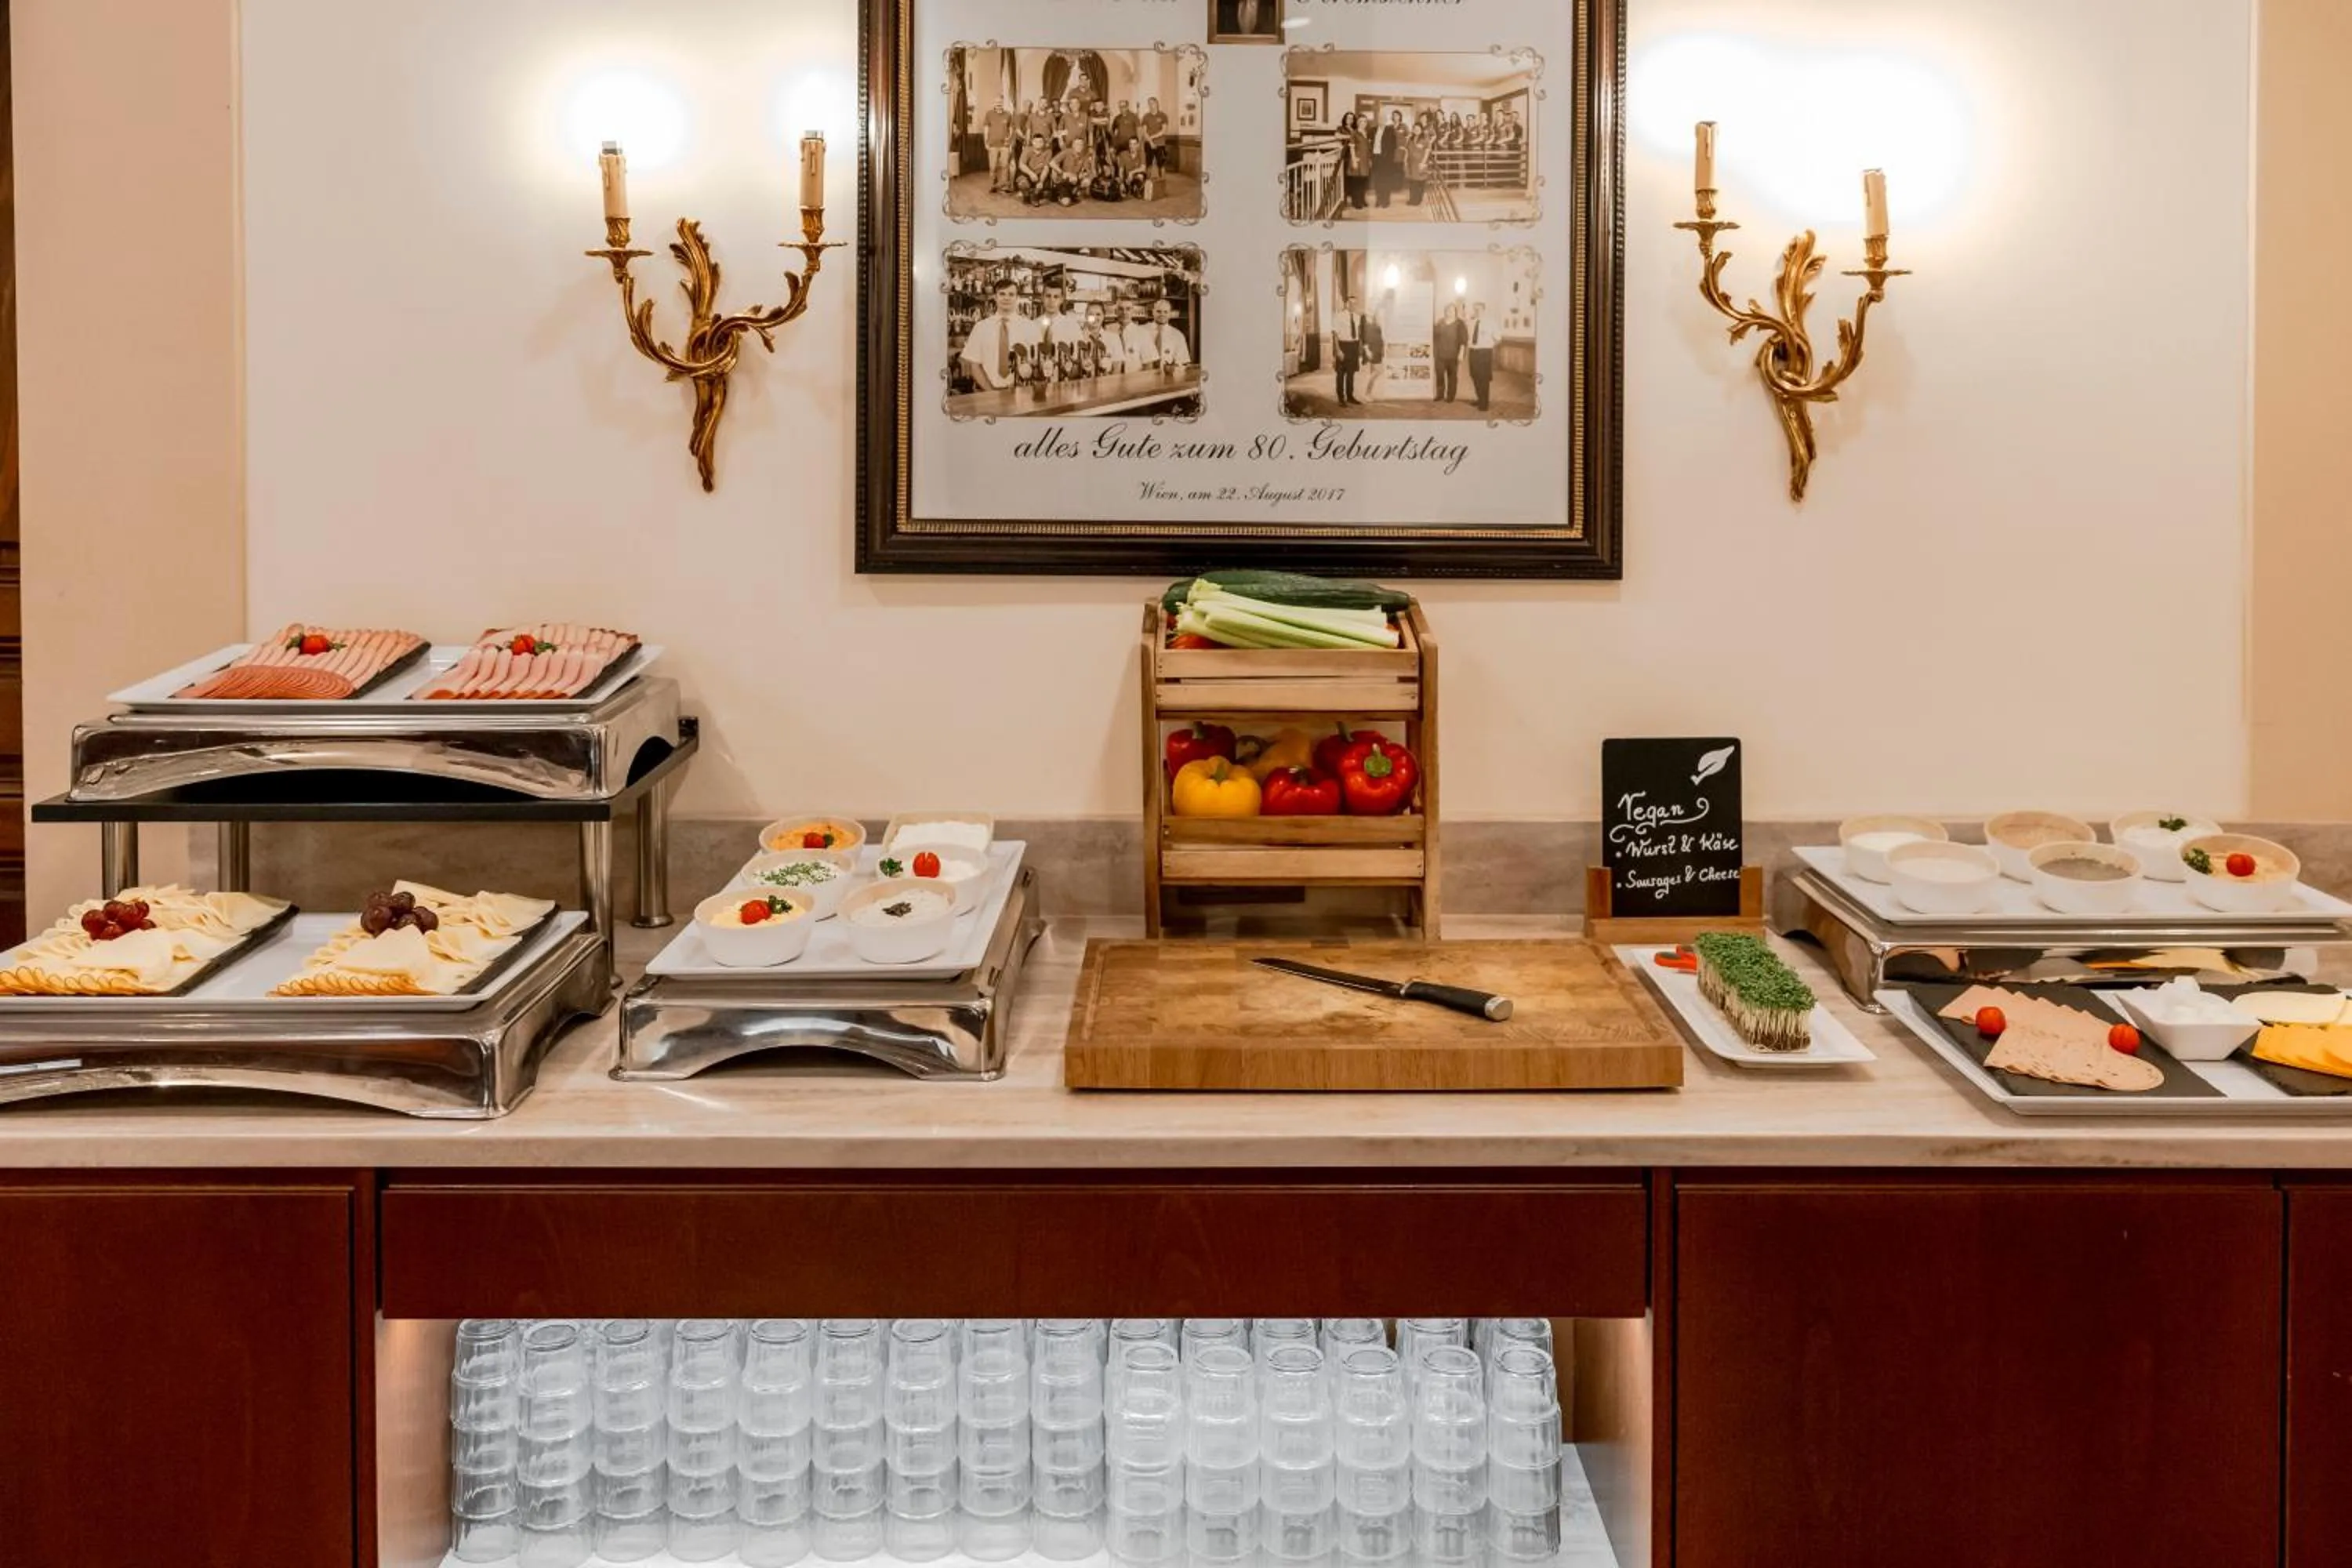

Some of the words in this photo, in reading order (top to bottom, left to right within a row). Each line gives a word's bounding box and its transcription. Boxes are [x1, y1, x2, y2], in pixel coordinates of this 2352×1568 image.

[1014, 426, 1080, 459] alles
[1092, 422, 1162, 459] Gute
[1169, 441, 1237, 459] zum
[1247, 434, 1295, 460] 80.
[1307, 424, 1469, 475] Geburtstag
[1139, 480, 1183, 502] Wien,
[1188, 491, 1211, 500] am
[1216, 486, 1242, 500] 22.
[1243, 482, 1305, 506] August
[1307, 488, 1346, 501] 2017
[1617, 791, 1685, 834] Vegan
[1625, 835, 1676, 858] Wurst
[1680, 834, 1695, 852] &
[1699, 833, 1739, 851] Käse
[1625, 869, 1682, 899] Sausages
[1685, 865, 1695, 882] &
[1698, 866, 1740, 882] Cheese
